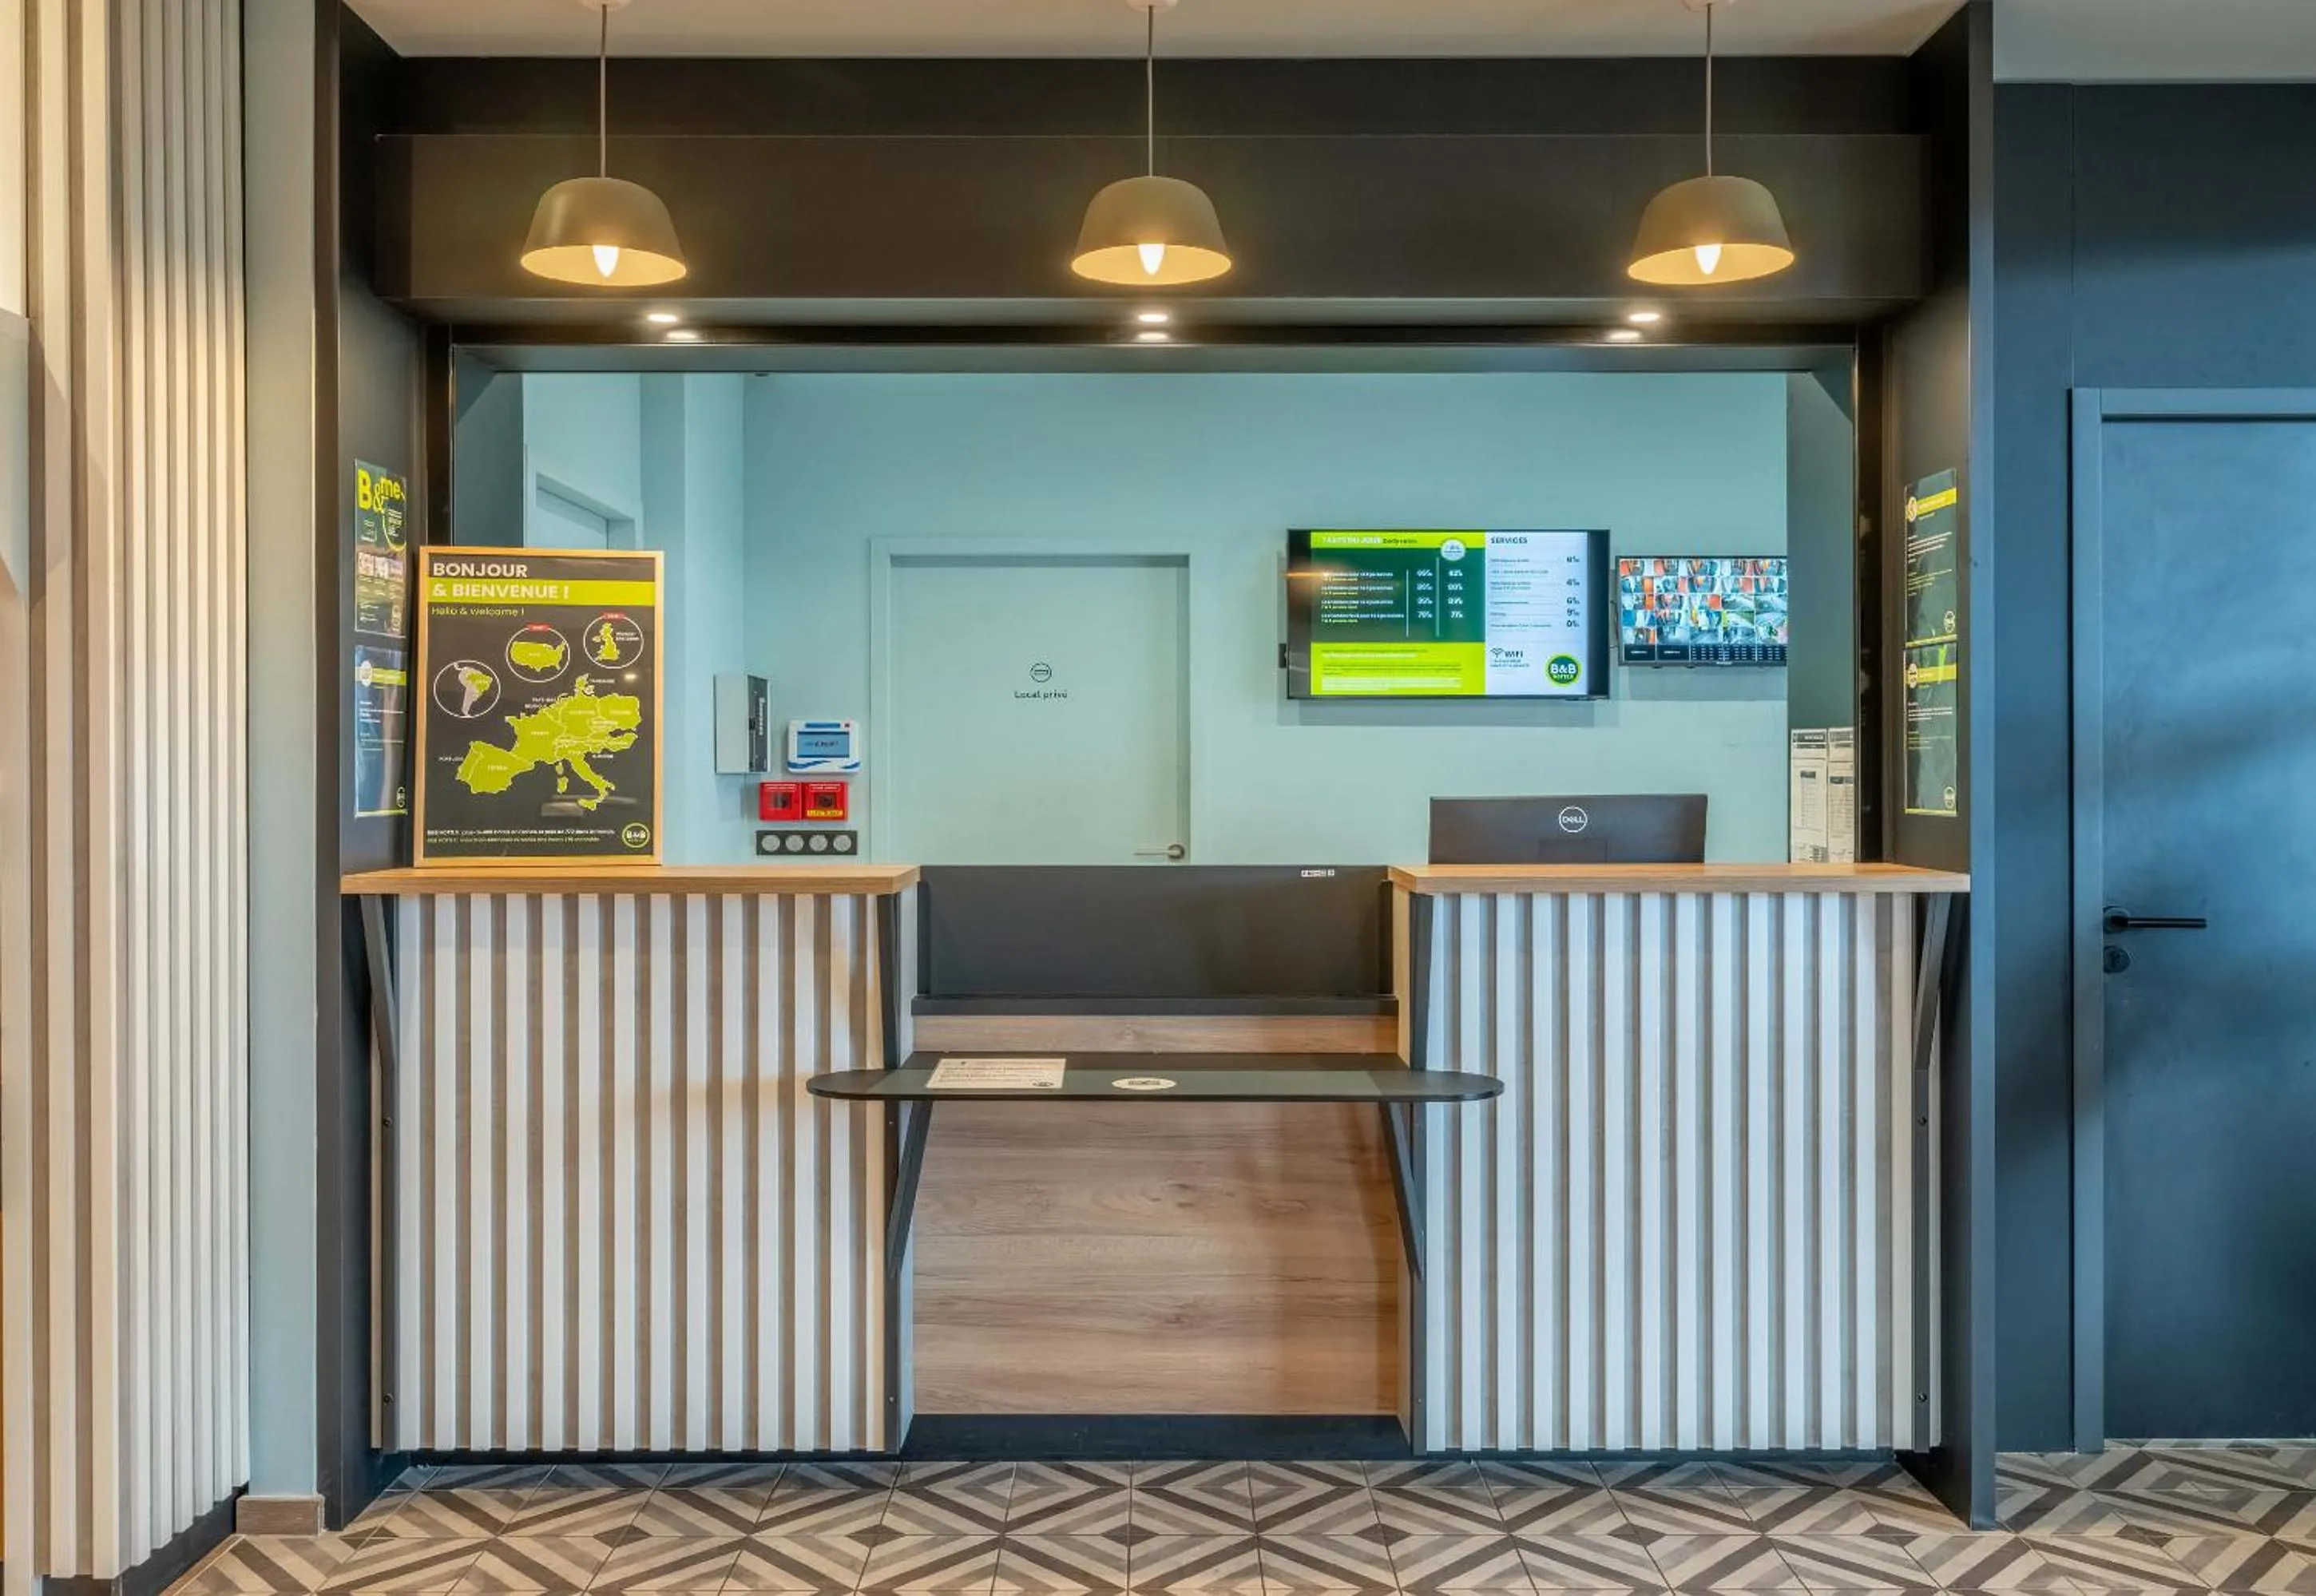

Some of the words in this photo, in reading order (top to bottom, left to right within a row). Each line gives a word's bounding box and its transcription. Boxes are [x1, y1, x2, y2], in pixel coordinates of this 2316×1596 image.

[433, 563, 528, 577] BONJOUR
[432, 583, 447, 597] &
[453, 584, 559, 599] BIENVENUE
[563, 585, 569, 599] !
[470, 608, 518, 617] welcome
[1551, 663, 1576, 674] B&B
